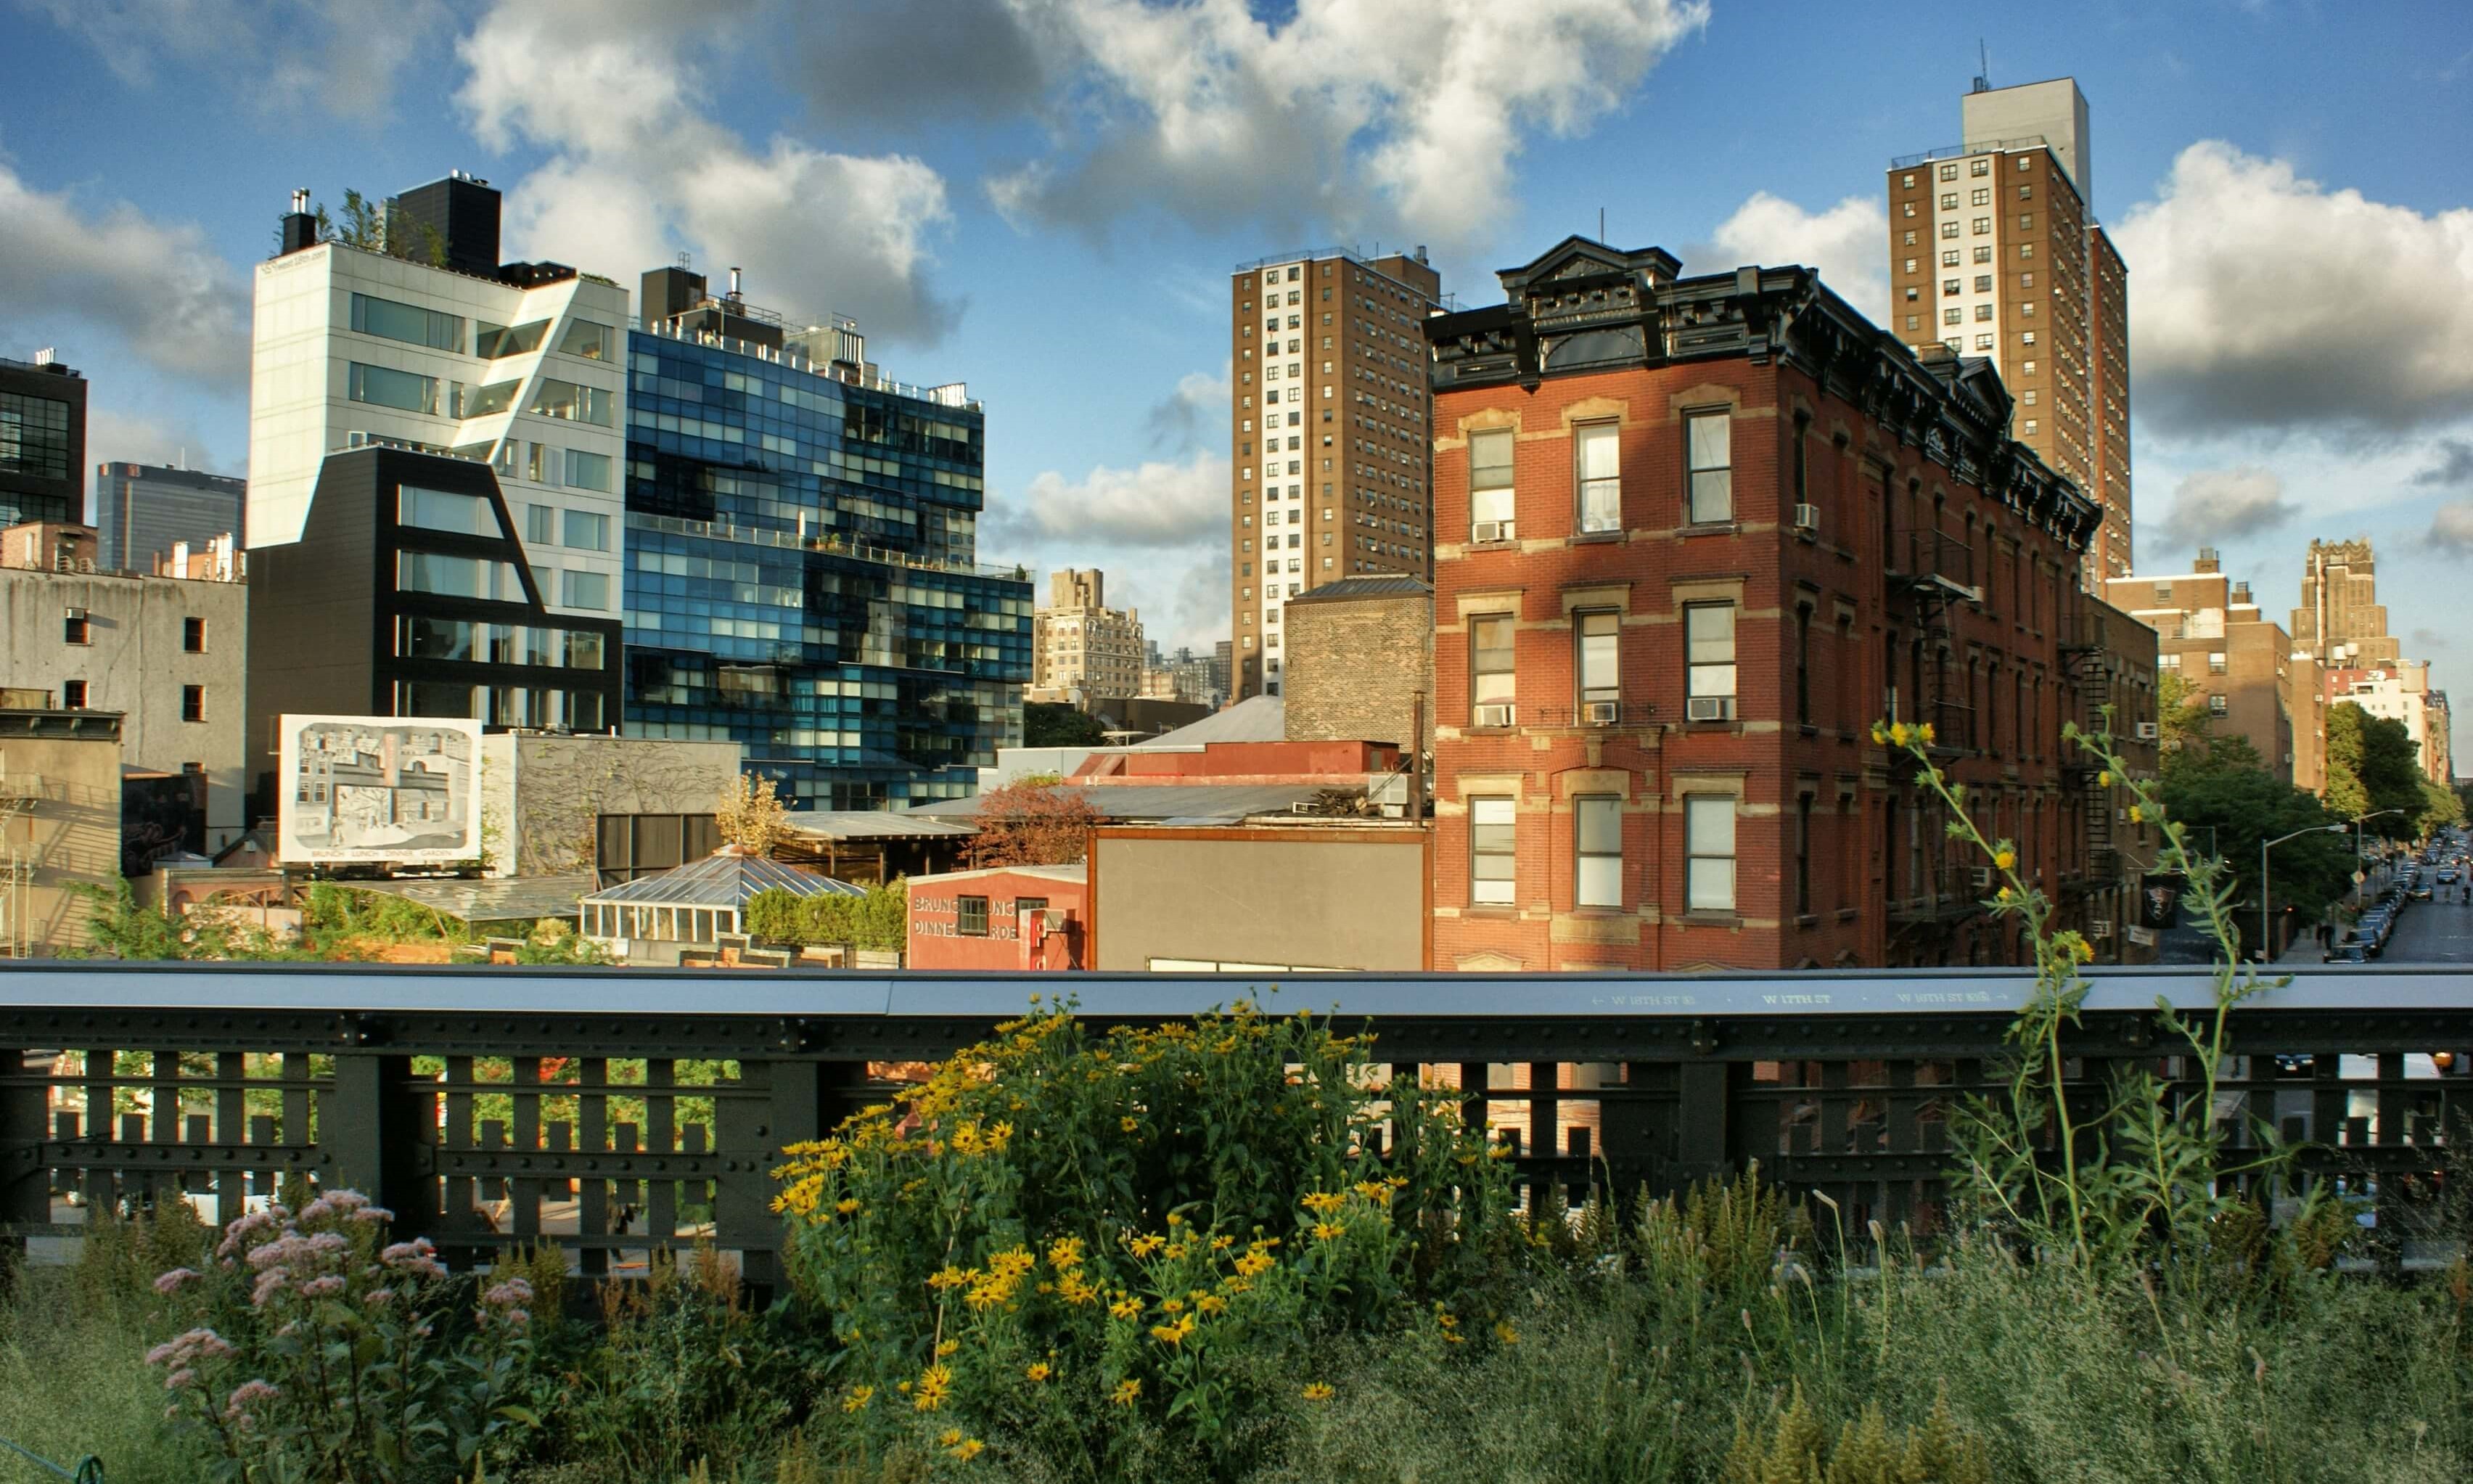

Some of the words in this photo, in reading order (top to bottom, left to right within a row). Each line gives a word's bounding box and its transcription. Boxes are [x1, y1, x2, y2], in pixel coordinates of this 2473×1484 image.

[915, 896, 959, 914] BRUNC
[1612, 996, 1625, 1005] W
[1663, 996, 1678, 1005] ST
[1761, 995, 1776, 1004] W
[1780, 995, 1812, 1004] 17TH
[1814, 995, 1830, 1004] ST
[1897, 993, 1910, 1003] W
[1948, 993, 1963, 1002] ST
